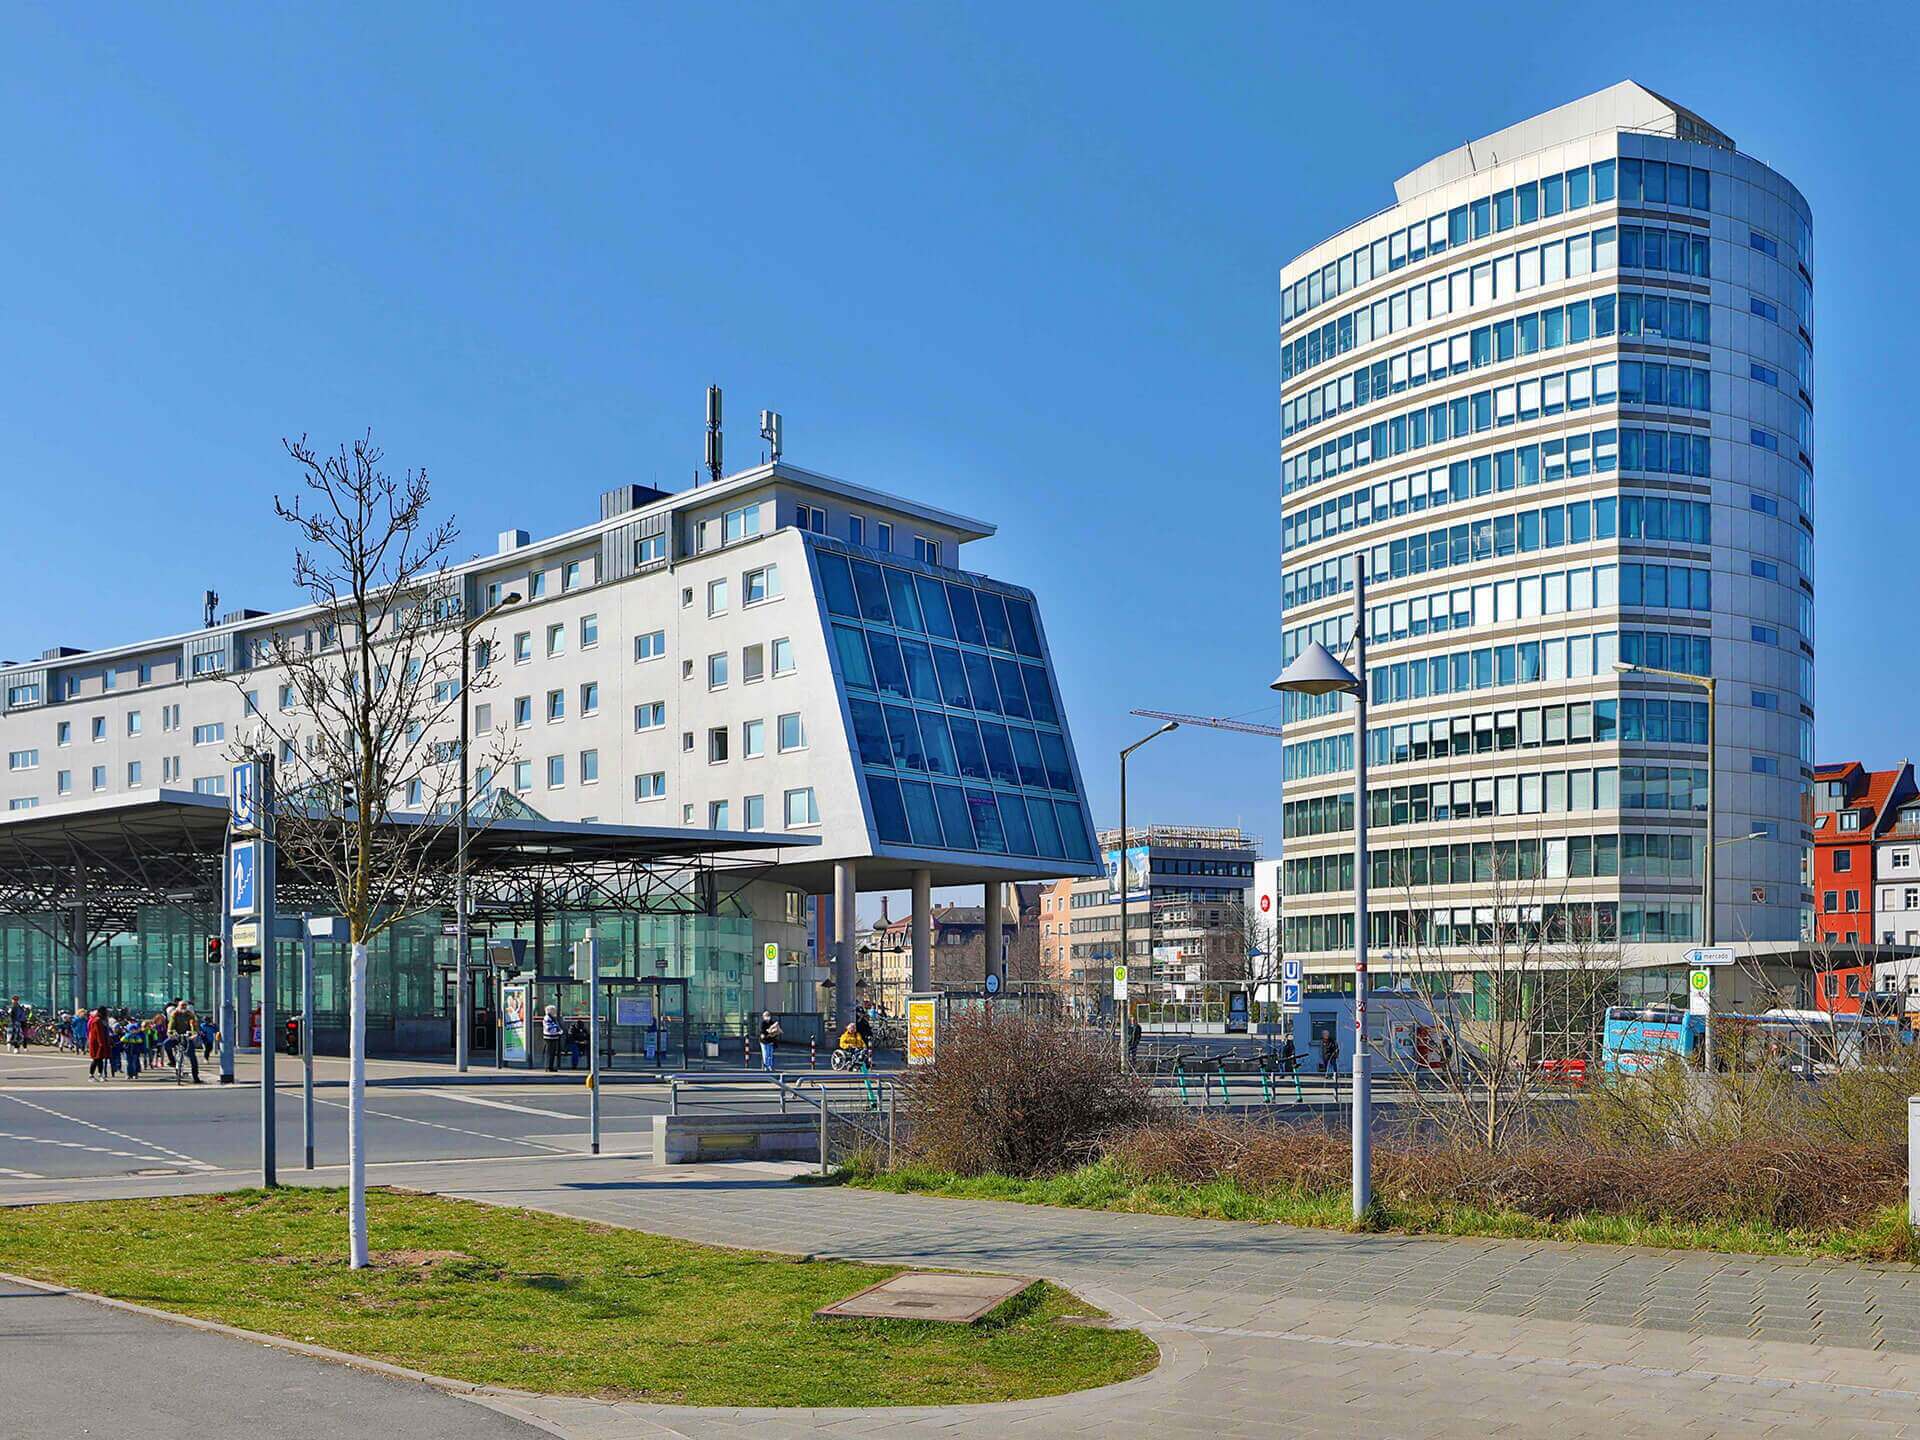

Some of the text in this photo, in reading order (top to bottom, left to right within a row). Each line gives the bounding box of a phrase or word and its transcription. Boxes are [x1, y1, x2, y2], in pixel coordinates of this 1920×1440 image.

[236, 767, 250, 819] U
[1703, 951, 1729, 960] mercado
[1286, 963, 1297, 978] U
